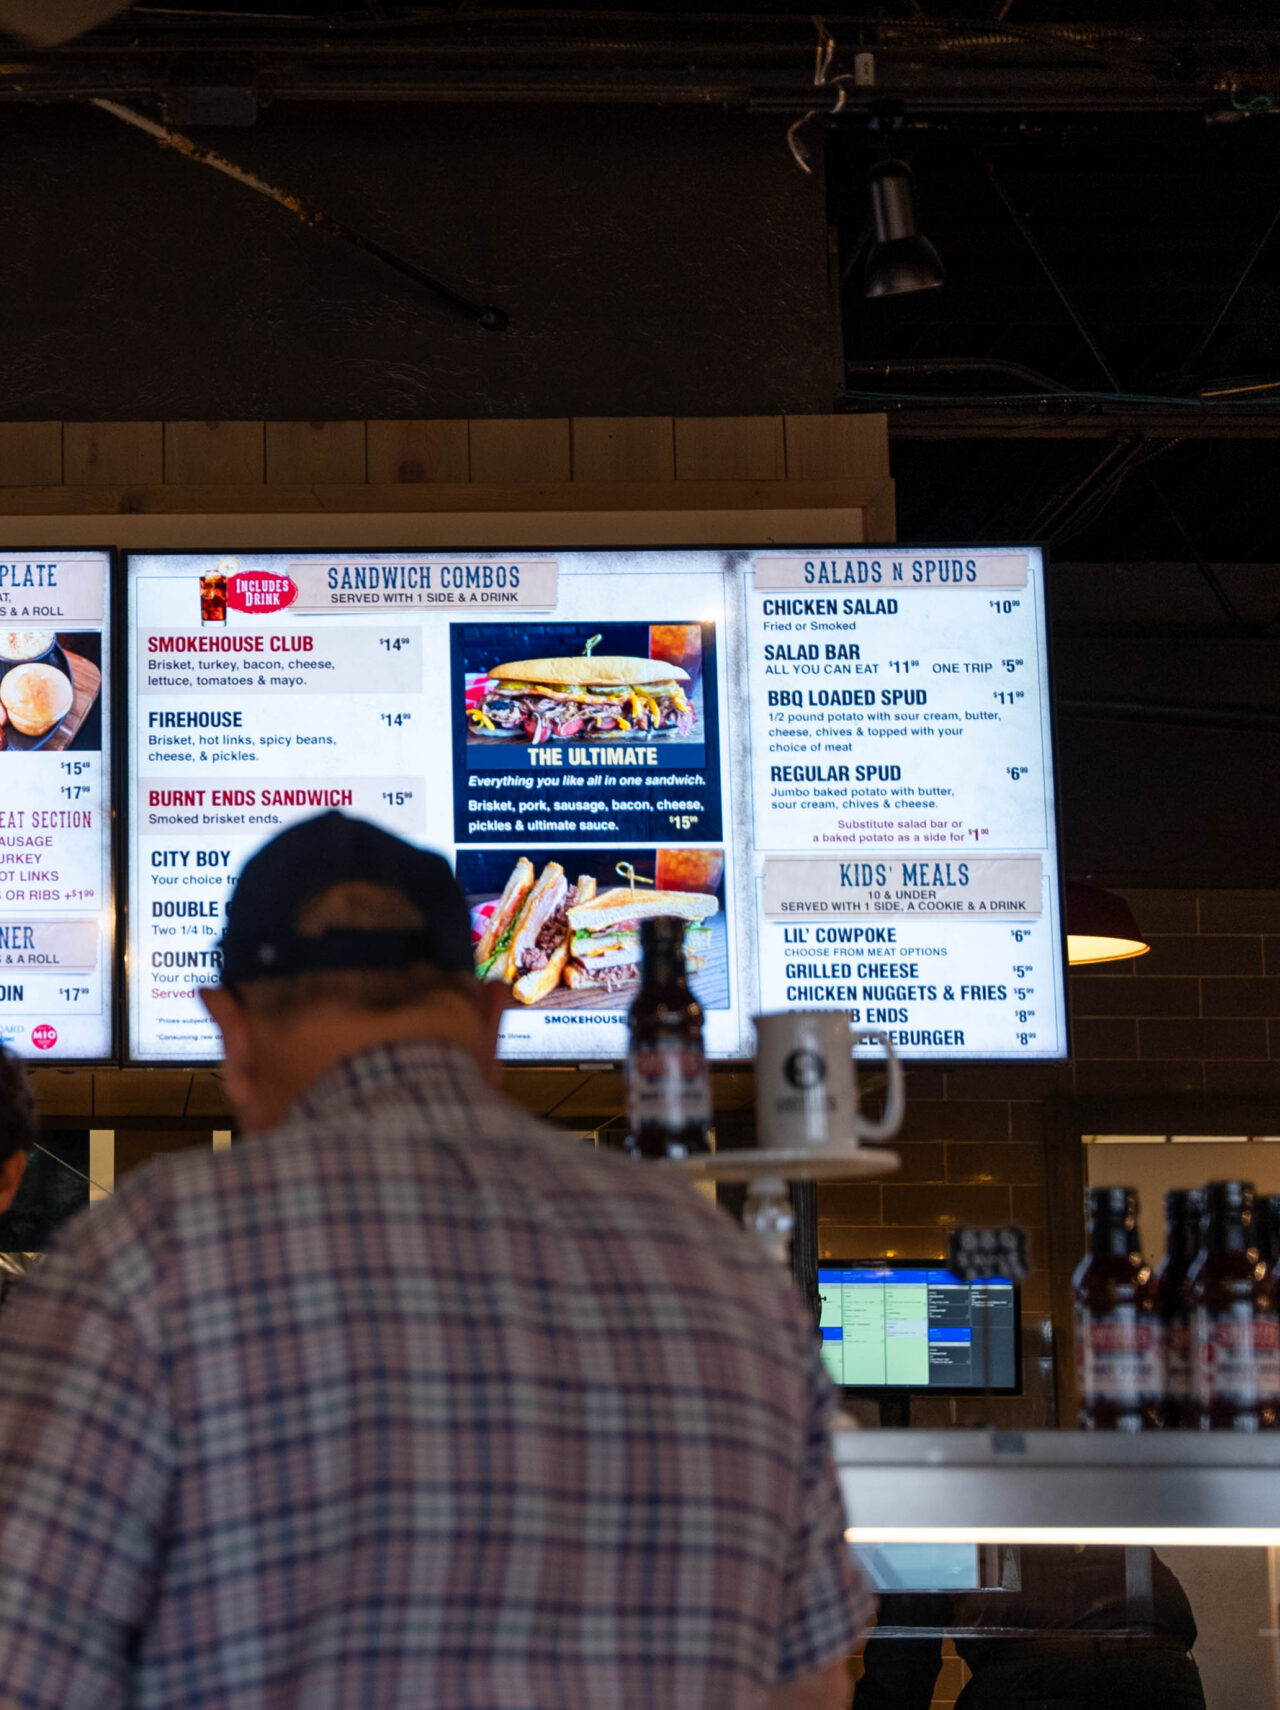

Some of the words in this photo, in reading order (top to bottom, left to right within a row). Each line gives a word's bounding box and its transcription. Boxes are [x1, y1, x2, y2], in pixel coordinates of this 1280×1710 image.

[328, 566, 431, 590] SANDWICH
[441, 566, 520, 588] COMBOS
[804, 561, 882, 584] SALADS
[892, 562, 903, 581] N
[912, 560, 976, 583] SPUDS
[234, 578, 290, 594] INCLUDES
[244, 590, 281, 606] DRINK
[763, 599, 838, 616] CHICKEN
[843, 598, 898, 615] SALAD
[763, 621, 792, 631] Fried
[795, 623, 807, 631] or
[810, 621, 856, 631] Smoked
[148, 636, 264, 653] SMOKEHOUSE
[270, 636, 314, 652] CLUB
[764, 644, 820, 661] SALAD
[825, 644, 860, 660] BAR
[148, 659, 195, 671] Brisket,
[198, 659, 239, 672] turkey,
[243, 659, 284, 670] bacon,
[288, 659, 335, 670] cheese,
[768, 690, 803, 708] BBQ
[808, 690, 876, 706] LOADED
[881, 689, 927, 706] SPUD
[149, 711, 242, 728] FIREHOUSE
[527, 748, 563, 766] THE
[568, 747, 658, 766] ULTIMATE
[770, 765, 850, 782] REGULAR
[855, 765, 901, 782] SPUD
[149, 790, 206, 807] BURNT
[212, 790, 256, 806] ENDS
[261, 789, 352, 807] SANDWICH
[32, 810, 92, 828] SECTION
[151, 850, 190, 867] CITY
[196, 850, 231, 867] BOY
[20, 870, 59, 882] LINKS
[840, 864, 892, 887] KIDS'
[902, 863, 969, 886] MEALS
[152, 901, 219, 918] DOUBLE
[784, 928, 809, 943] LIL'
[816, 928, 896, 943] COWPOKE
[786, 963, 852, 979] GRILLED
[857, 963, 919, 979] CHEESE
[787, 986, 857, 1001] CHICKEN
[862, 985, 937, 1001] NUGGETS
[943, 985, 955, 1001] &
[960, 984, 1007, 1000] FRIES
[866, 1008, 908, 1023] ENDS
